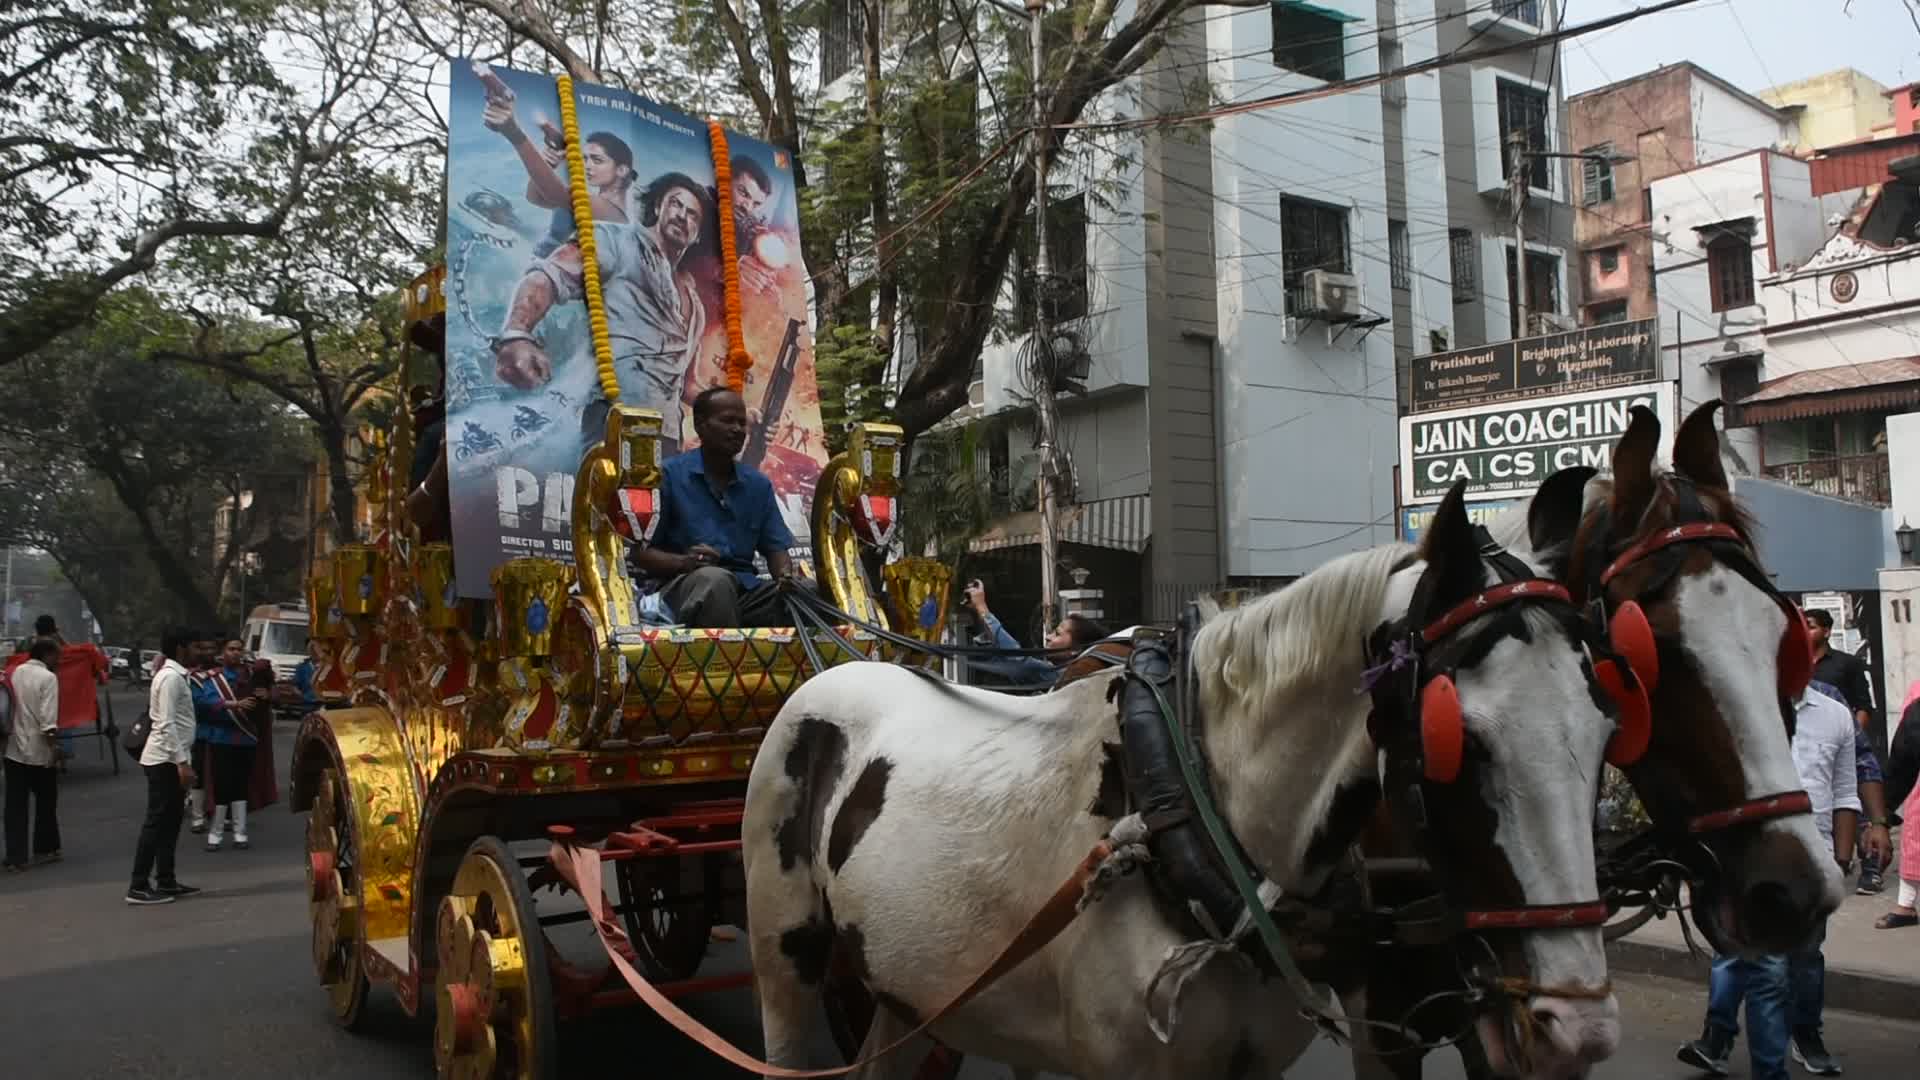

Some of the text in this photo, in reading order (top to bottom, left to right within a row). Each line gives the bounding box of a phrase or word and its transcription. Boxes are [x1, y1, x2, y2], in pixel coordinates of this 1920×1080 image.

[611, 99, 632, 112] RAJ
[633, 105, 662, 126] FILMS
[1588, 333, 1649, 351] Laboratory
[1430, 350, 1494, 371] Pratishruti
[1557, 354, 1613, 374] Diagnostic
[1414, 418, 1476, 455] JAIN
[1427, 457, 1472, 484] CA
[1489, 451, 1536, 478] CS
[501, 535, 546, 549] DIRECTOR
[552, 538, 574, 552] SID
